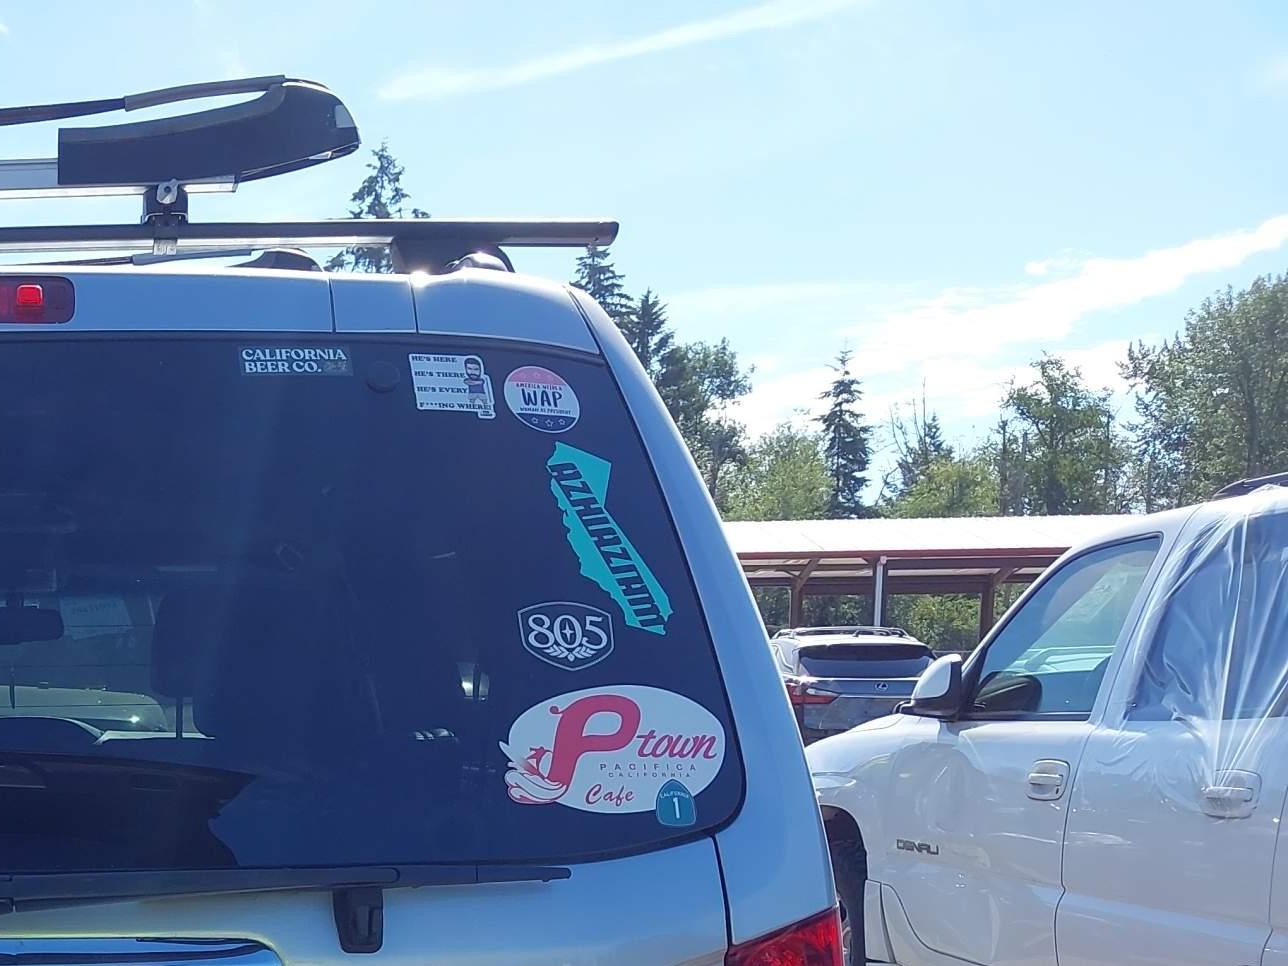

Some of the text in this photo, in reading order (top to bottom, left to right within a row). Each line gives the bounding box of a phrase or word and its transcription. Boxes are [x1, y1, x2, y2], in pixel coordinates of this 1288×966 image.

[242, 349, 347, 360] CALIFORNIA
[245, 361, 322, 373] BEER CO.
[521, 388, 563, 408] WAP
[527, 614, 608, 650] 805
[600, 763, 697, 772] PACIFICA
[585, 783, 635, 807] Cafe
[672, 797, 681, 819] 1
[896, 838, 940, 856] DENALI
